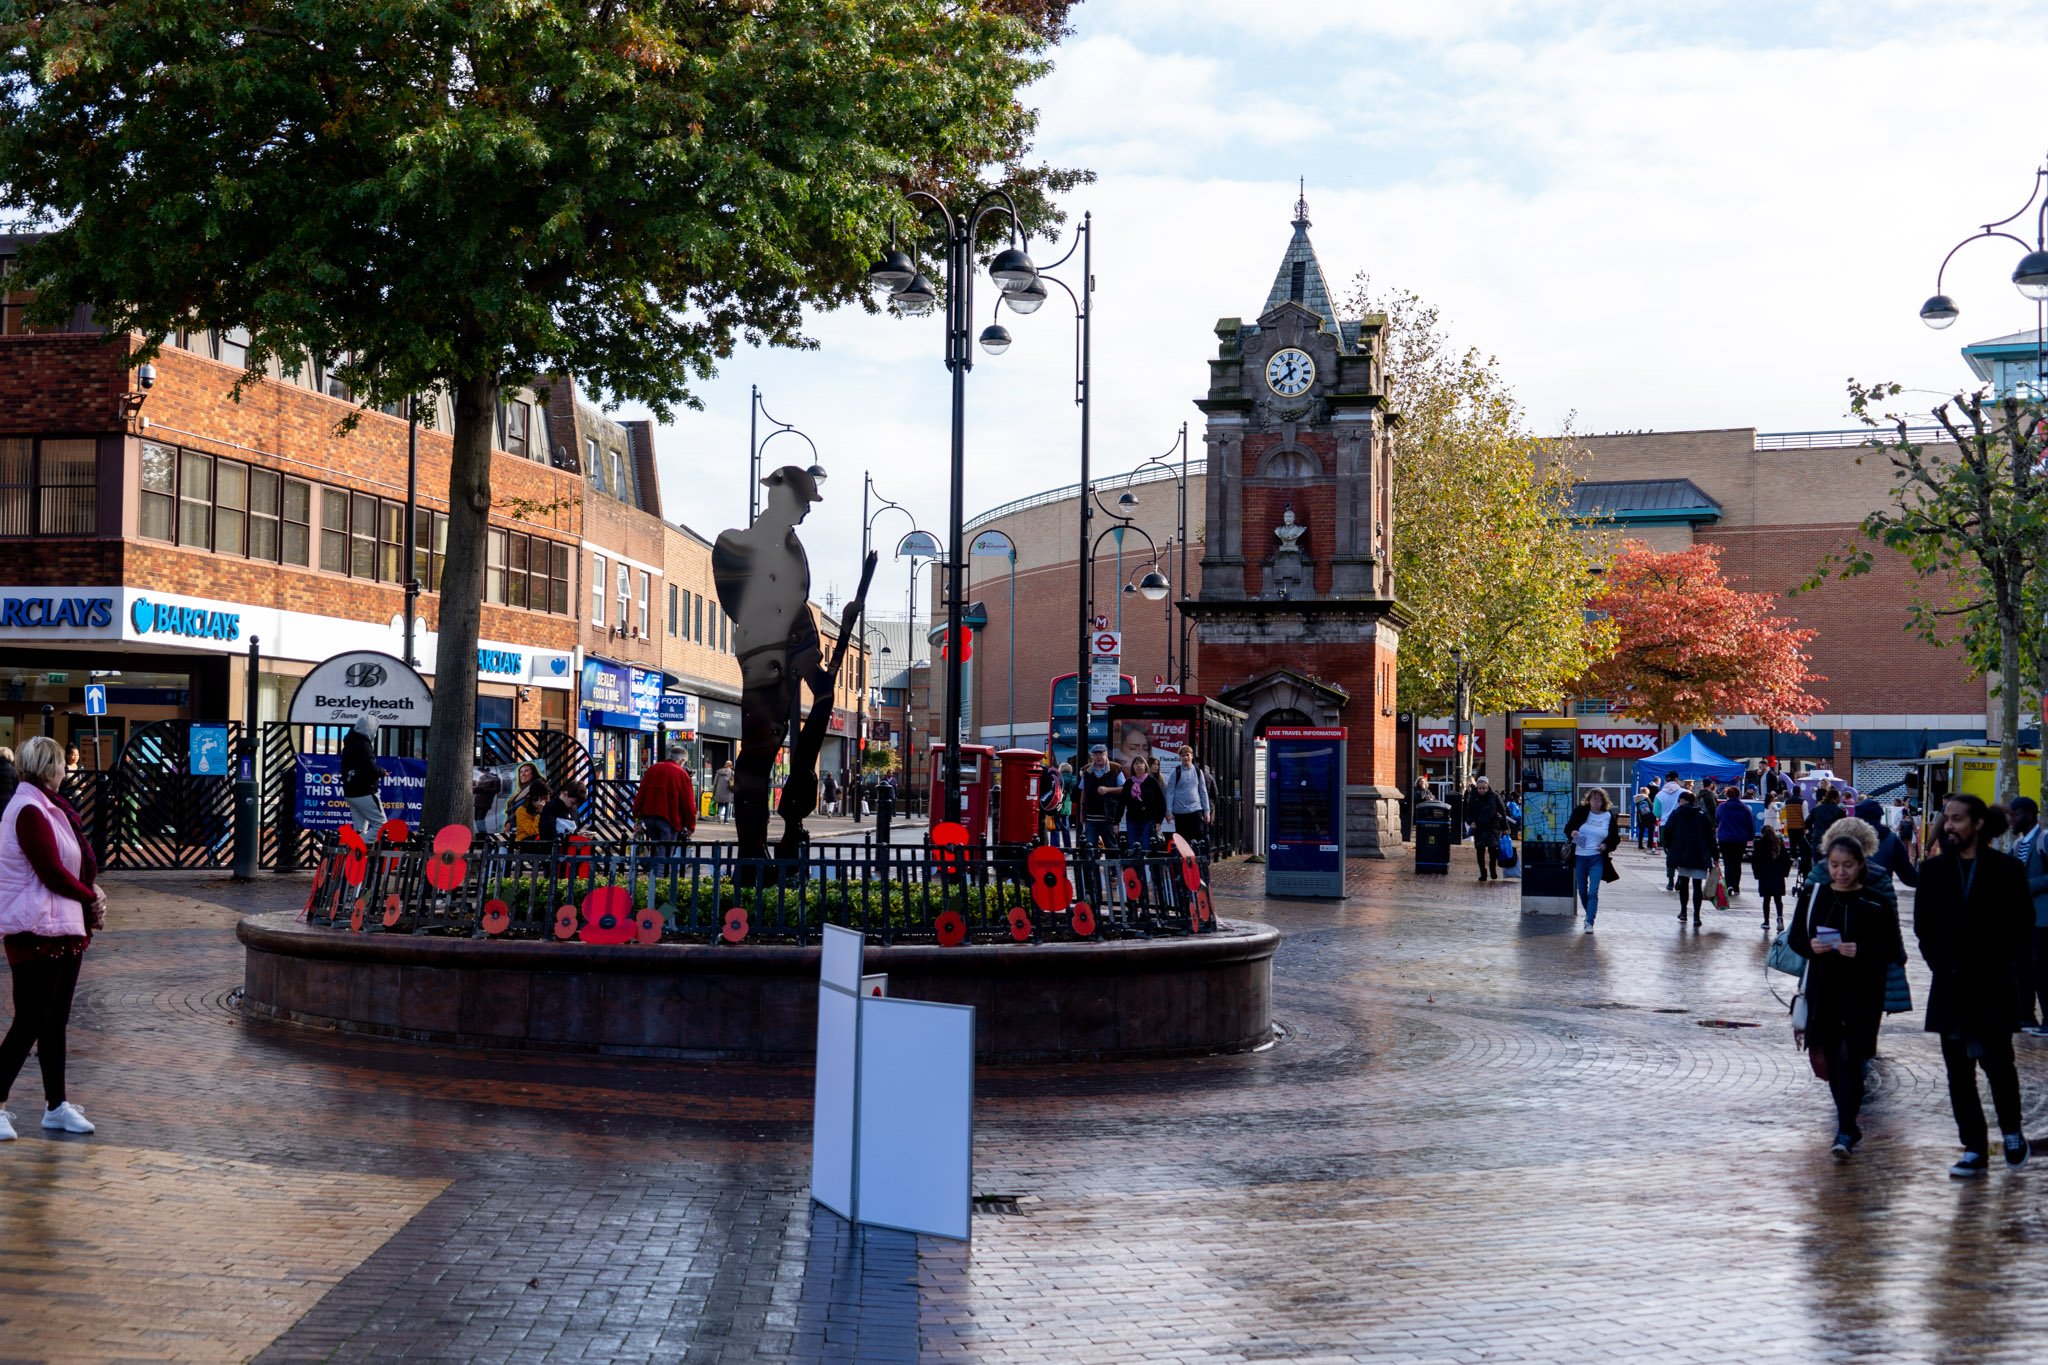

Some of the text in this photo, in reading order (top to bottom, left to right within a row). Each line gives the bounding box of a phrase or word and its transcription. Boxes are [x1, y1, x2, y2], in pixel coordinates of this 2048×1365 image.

[0, 598, 113, 627] RCLAYS
[154, 603, 240, 641] BARCLAYS
[1095, 617, 1107, 628] M
[478, 649, 523, 675] ARCLAYS
[1155, 675, 1161, 683] L
[315, 695, 415, 711] Bexleyheath
[661, 697, 685, 705] FOOD
[331, 710, 359, 720] Town
[1151, 722, 1187, 735] Tired
[305, 786, 332, 796] THIS
